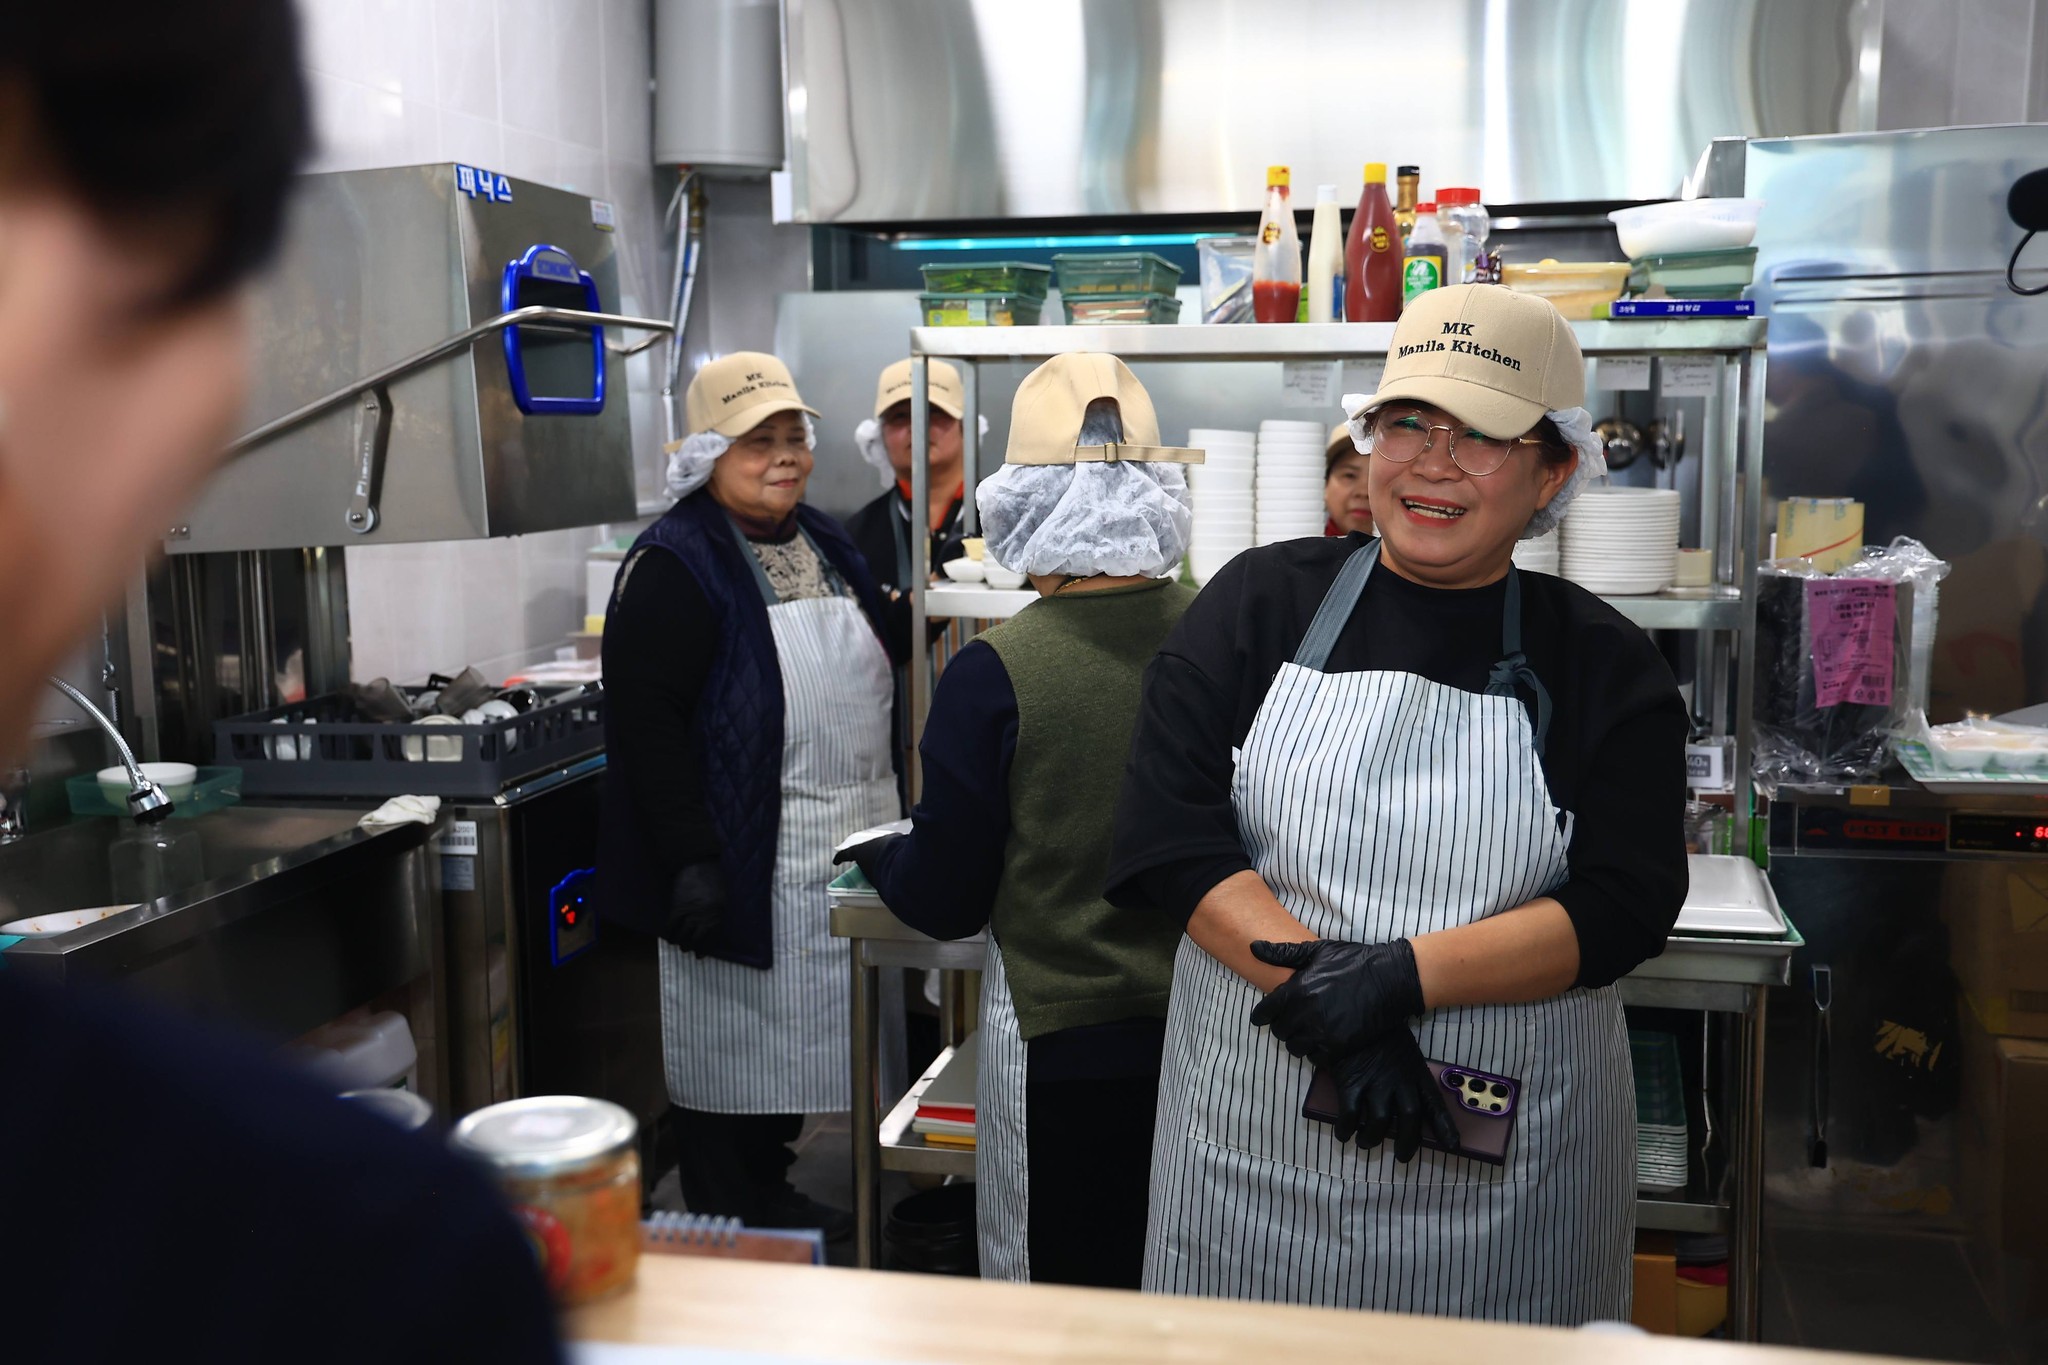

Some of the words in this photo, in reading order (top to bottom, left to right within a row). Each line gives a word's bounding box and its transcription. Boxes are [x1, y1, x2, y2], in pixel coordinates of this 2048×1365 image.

[1441, 322, 1475, 336] MK
[1398, 340, 1446, 359] Manila
[1450, 339, 1521, 371] Kitchen
[721, 385, 756, 404] Manila
